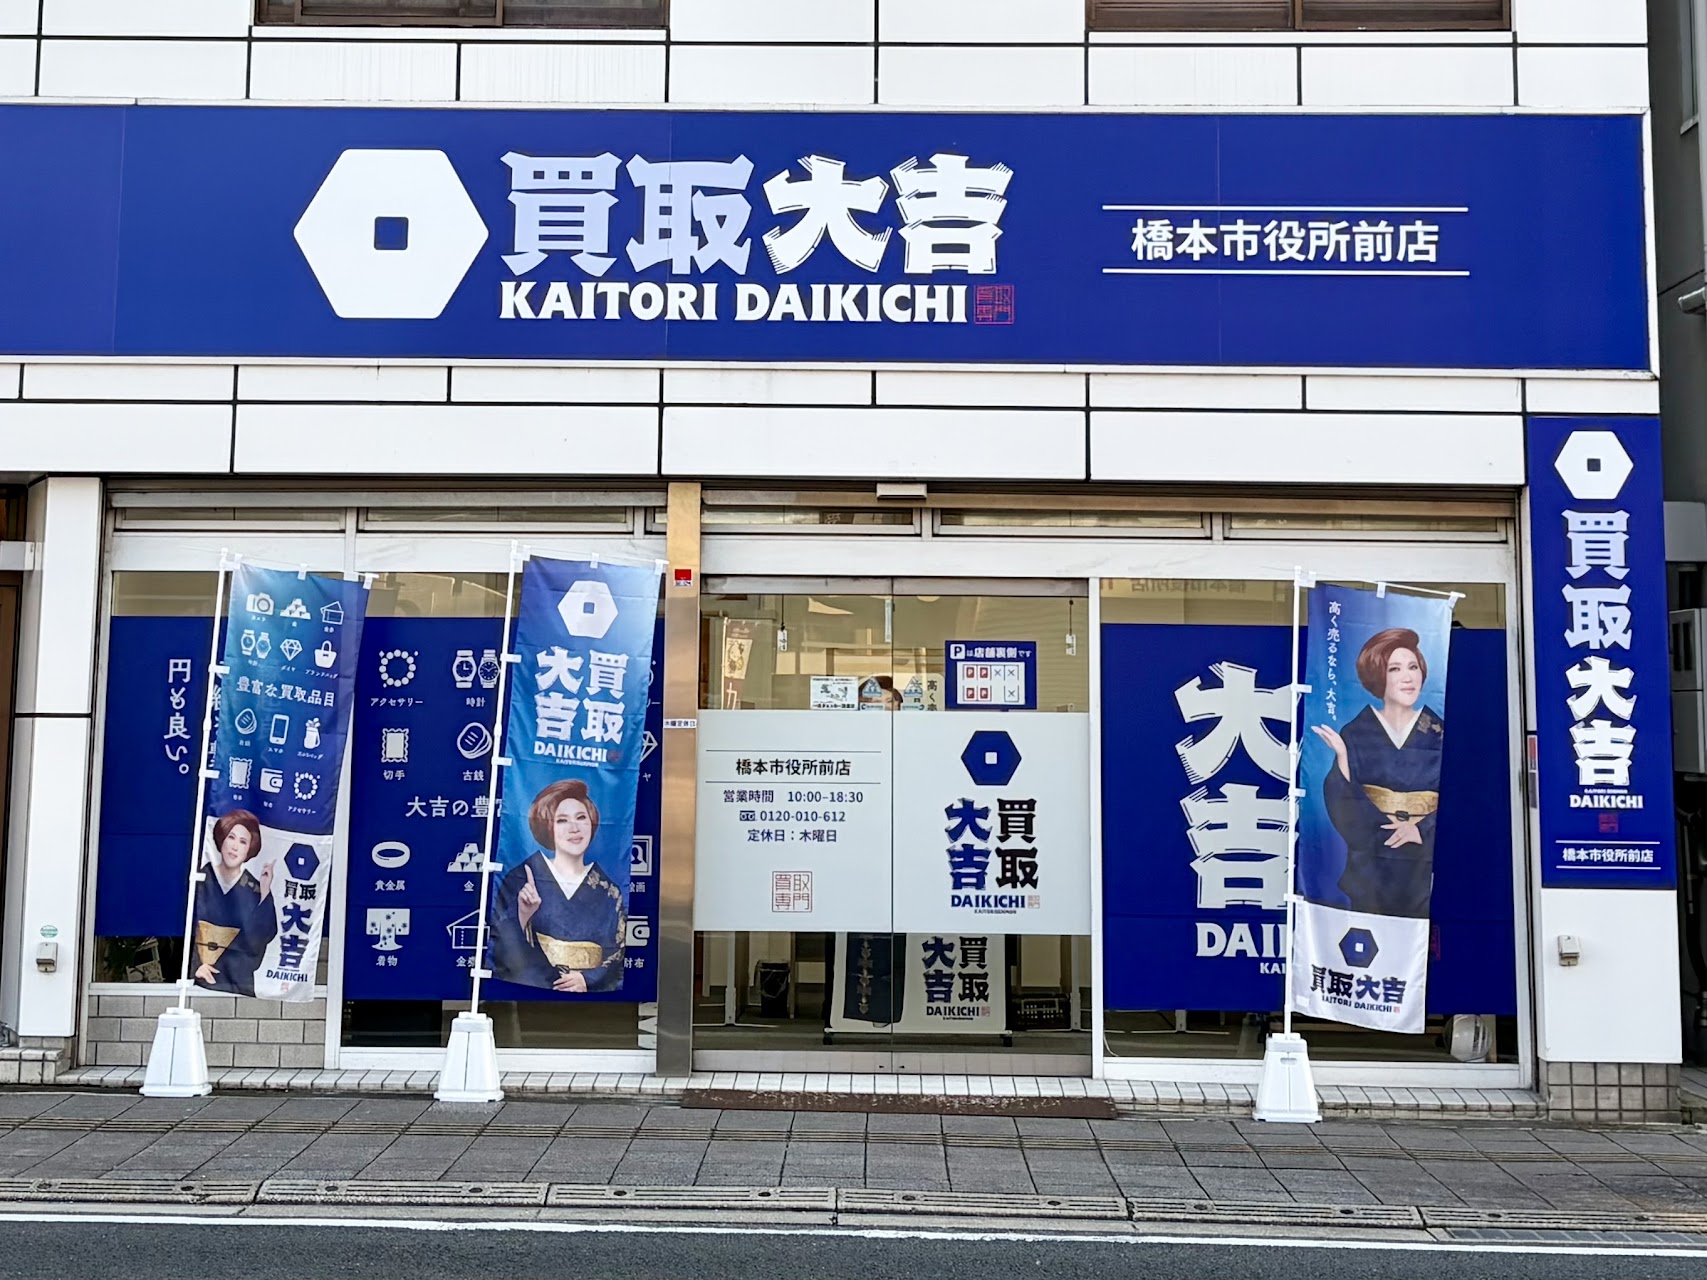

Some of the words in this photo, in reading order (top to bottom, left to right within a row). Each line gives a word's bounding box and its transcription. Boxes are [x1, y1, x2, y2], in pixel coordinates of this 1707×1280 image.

[500, 152, 1014, 275] 買取大吉
[1132, 218, 1439, 263] 橋本市役所前店
[500, 281, 718, 321] KAITORI
[735, 283, 968, 323] DAIKICHI
[1561, 509, 1637, 786] 買取大吉
[236, 675, 335, 707] 豊富な買取品目
[534, 645, 584, 742] 大吉
[580, 649, 629, 745] 買取
[370, 697, 424, 707] アクセサリー
[466, 697, 485, 707] 時計
[533, 741, 608, 762] DAIKICHI
[383, 769, 405, 780] 切手
[736, 758, 852, 776] 橋本市役所前店
[723, 789, 774, 803] 営業時間
[1569, 794, 1644, 809] DAIKICHI
[760, 810, 846, 823] 0120-010-612
[944, 797, 993, 890] 大吉
[995, 798, 1039, 889] 買取
[1562, 847, 1654, 863] 橋本市役所前店
[284, 879, 317, 900] 買取
[375, 880, 405, 891] 貴金属
[463, 881, 474, 891] 金
[951, 894, 1026, 908] DAIKICHI
[279, 902, 314, 968] 大吉
[376, 955, 398, 967] 着物
[921, 936, 957, 1003] 大吉
[958, 936, 989, 1003] 買取
[266, 969, 308, 982] DAIKICHI
[926, 1005, 980, 1017] DAIKICHI
[1354, 1001, 1392, 1013] DAIKICHI
